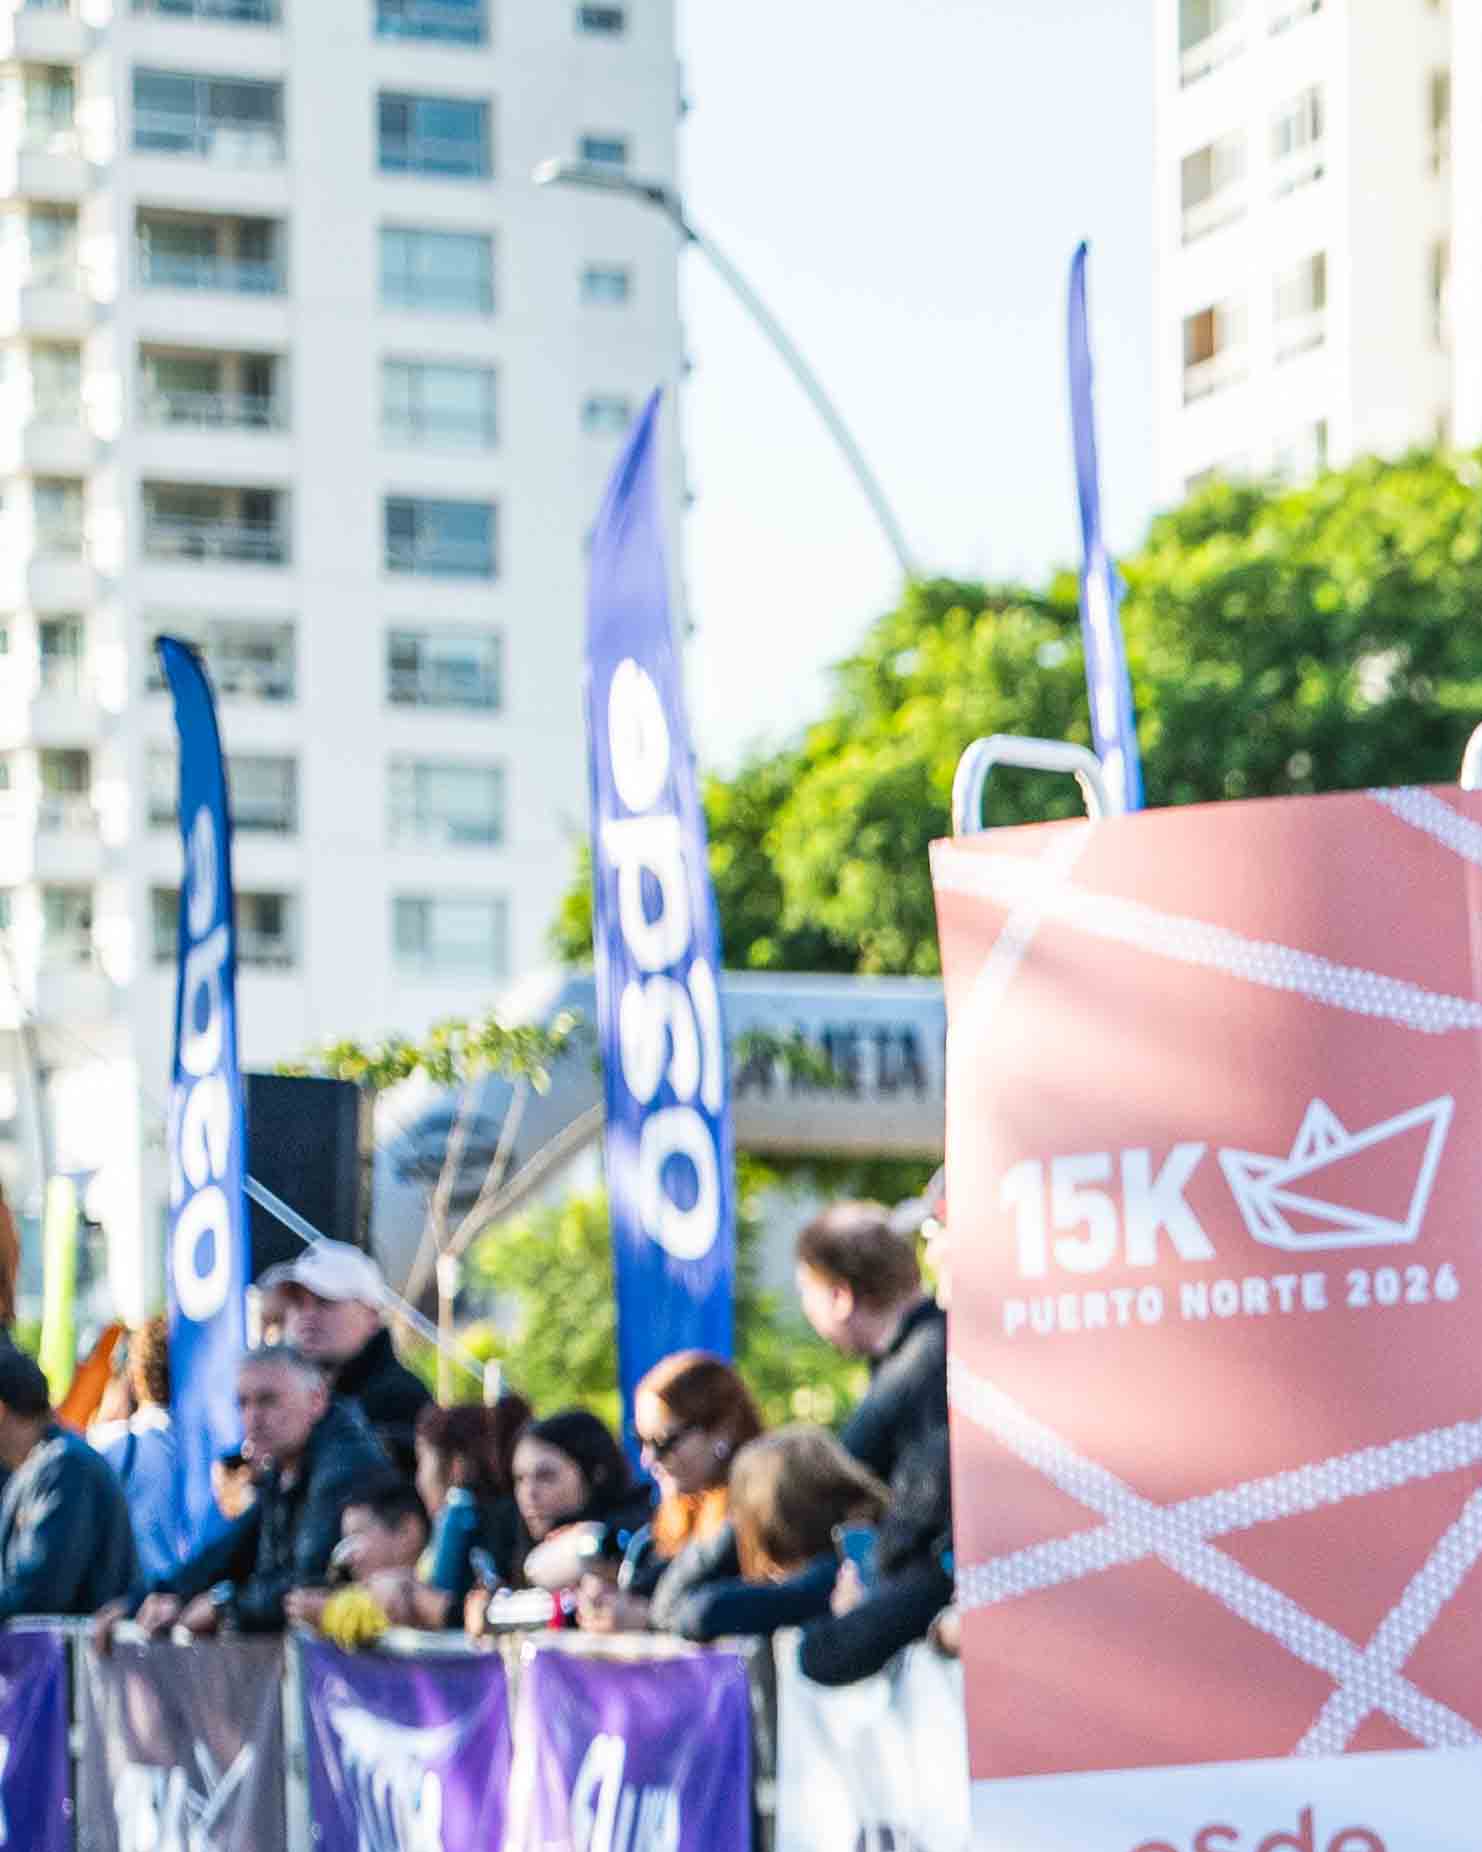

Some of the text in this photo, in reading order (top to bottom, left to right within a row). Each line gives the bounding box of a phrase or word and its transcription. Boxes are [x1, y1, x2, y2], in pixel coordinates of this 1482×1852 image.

[999, 1141, 1217, 1281] 15K
[1002, 1262, 1461, 1337] PUERTO NORTE 2026
